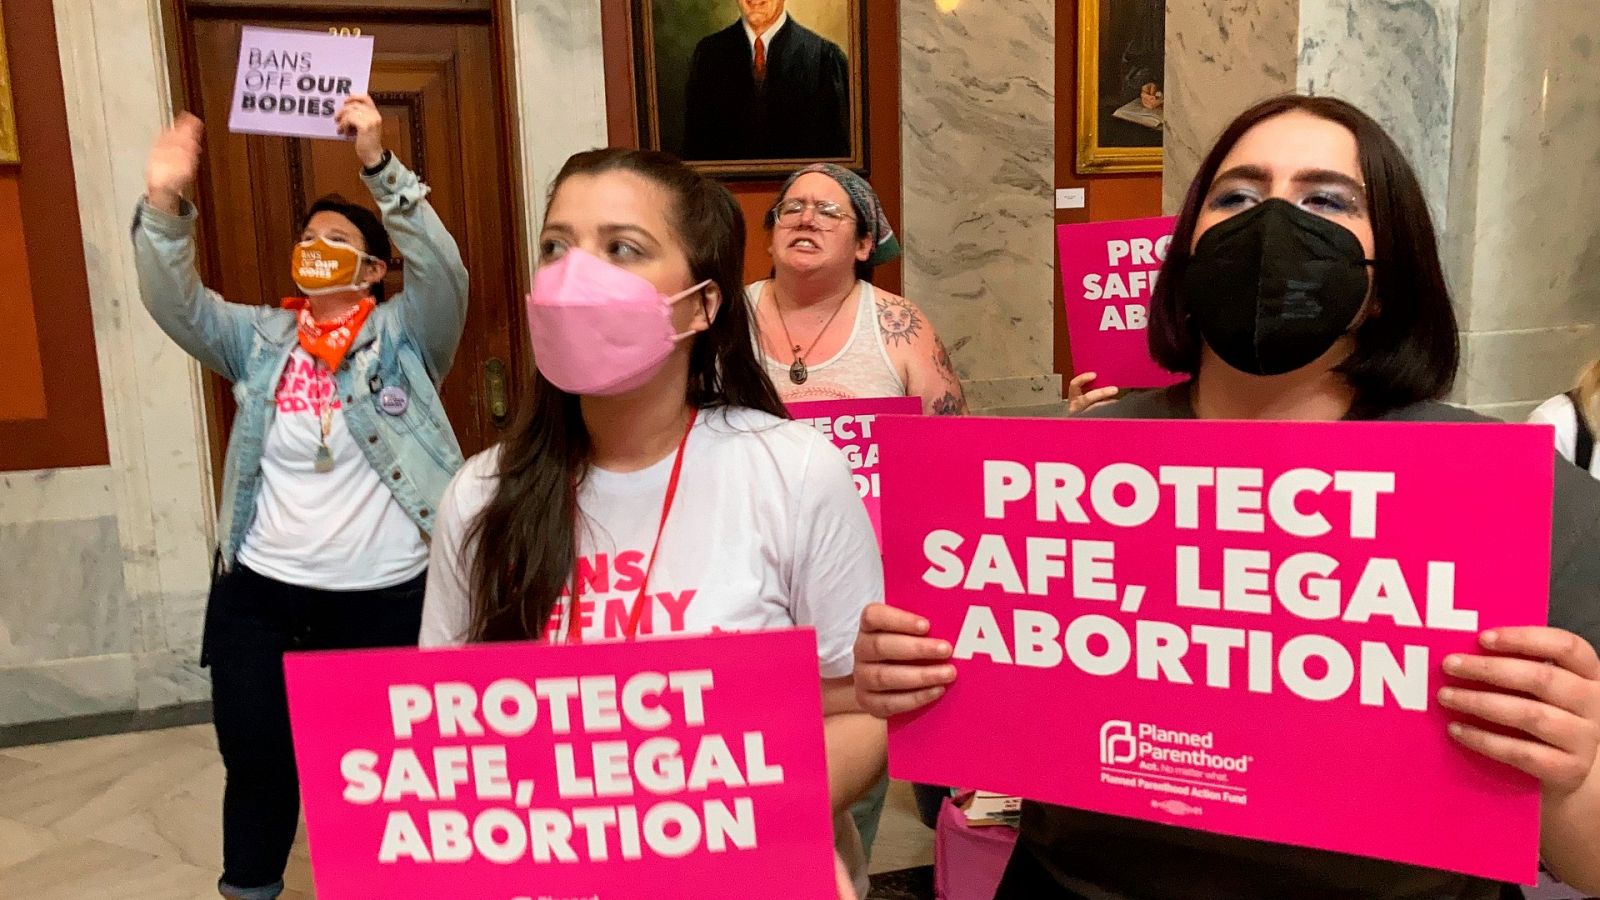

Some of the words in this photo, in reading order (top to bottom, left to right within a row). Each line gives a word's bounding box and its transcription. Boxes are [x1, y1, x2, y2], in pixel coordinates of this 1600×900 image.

[245, 70, 291, 91] OFF
[296, 76, 353, 96] OUR
[248, 47, 312, 72] BANS
[241, 92, 336, 117] BODIES
[983, 459, 1396, 539] PROTECT
[922, 529, 1146, 613] SAFE,
[1175, 545, 1479, 632] LEGAL
[952, 605, 1430, 711] ABORTION
[388, 669, 714, 739] PROTECT
[1138, 723, 1214, 749] Planned
[340, 745, 534, 808] SAFE,
[554, 731, 784, 798] LEGAL
[1100, 772, 1137, 787] Planned
[1138, 778, 1190, 796] Parenthood
[1191, 787, 1222, 801] Action
[1223, 791, 1248, 805] Fund
[378, 797, 757, 864] ABORTION
